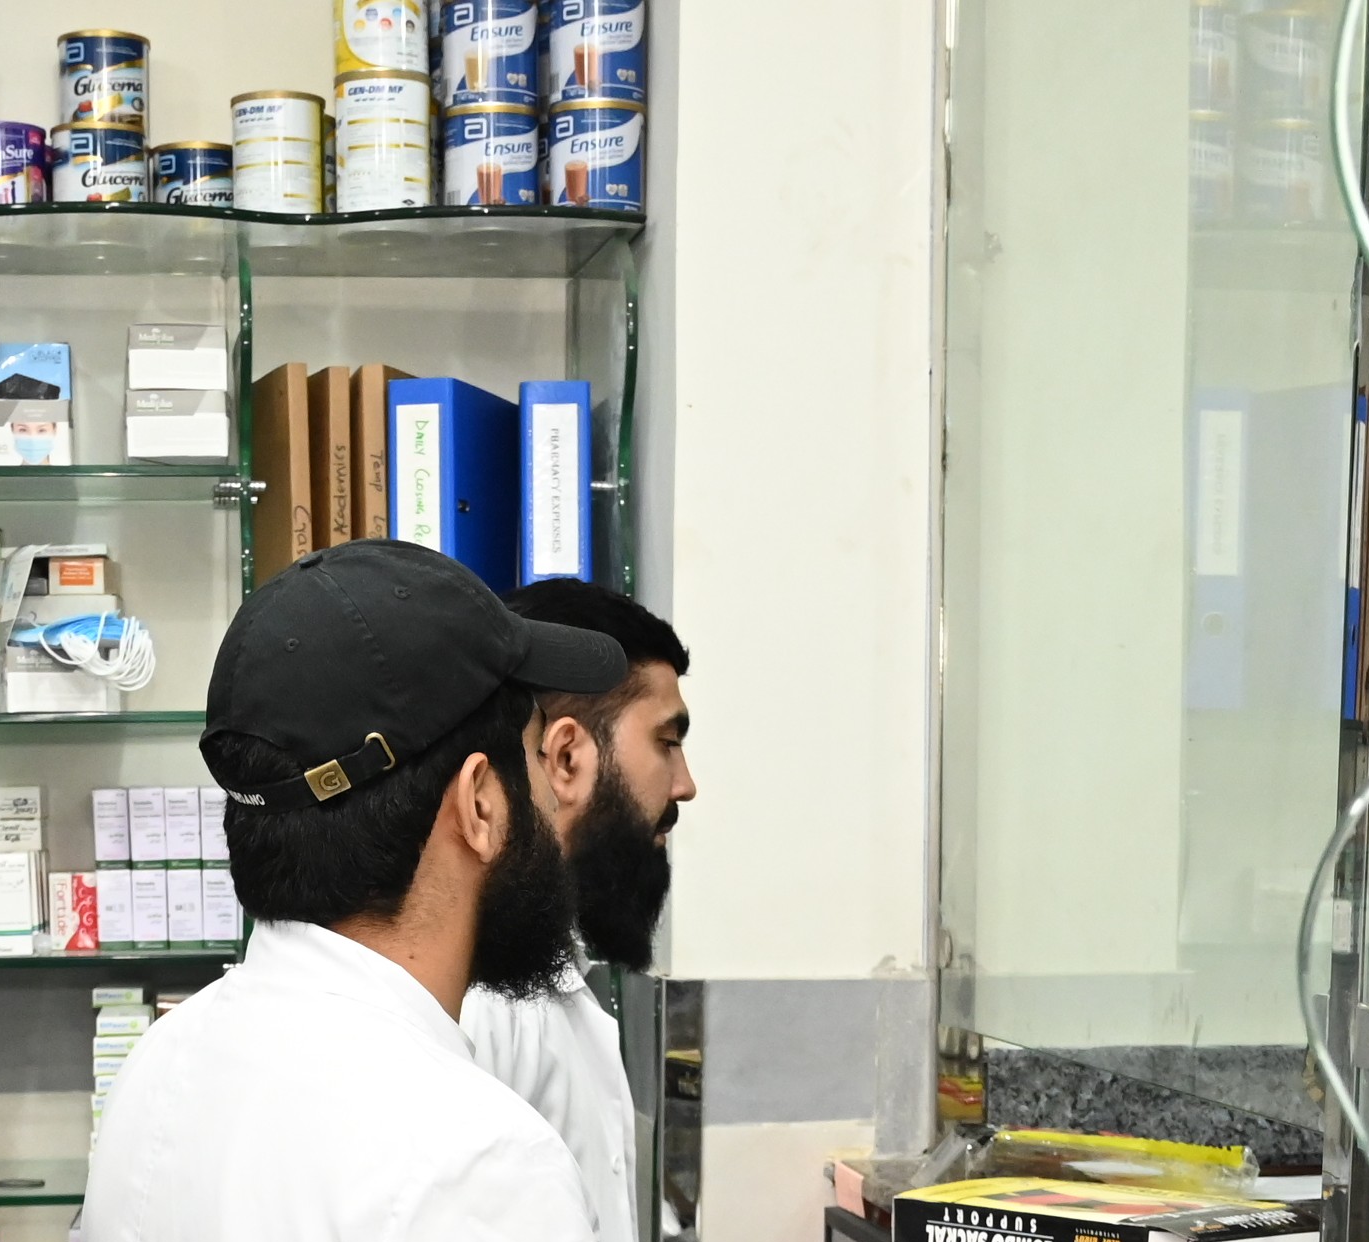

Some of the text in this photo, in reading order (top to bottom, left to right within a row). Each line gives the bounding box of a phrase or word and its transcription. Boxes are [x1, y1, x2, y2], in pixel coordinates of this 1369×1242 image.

[470, 22, 523, 42] Ensure
[580, 17, 633, 37] Ensure
[74, 75, 142, 97] Glucerna
[484, 138, 533, 156] Ensure
[571, 134, 624, 155] Ensure
[412, 419, 427, 457] DAILY
[366, 451, 385, 493] Temp
[331, 443, 348, 536] Academics
[412, 468, 431, 516] CLOSING
[548, 426, 563, 555] PHARMACY EXPENSES
